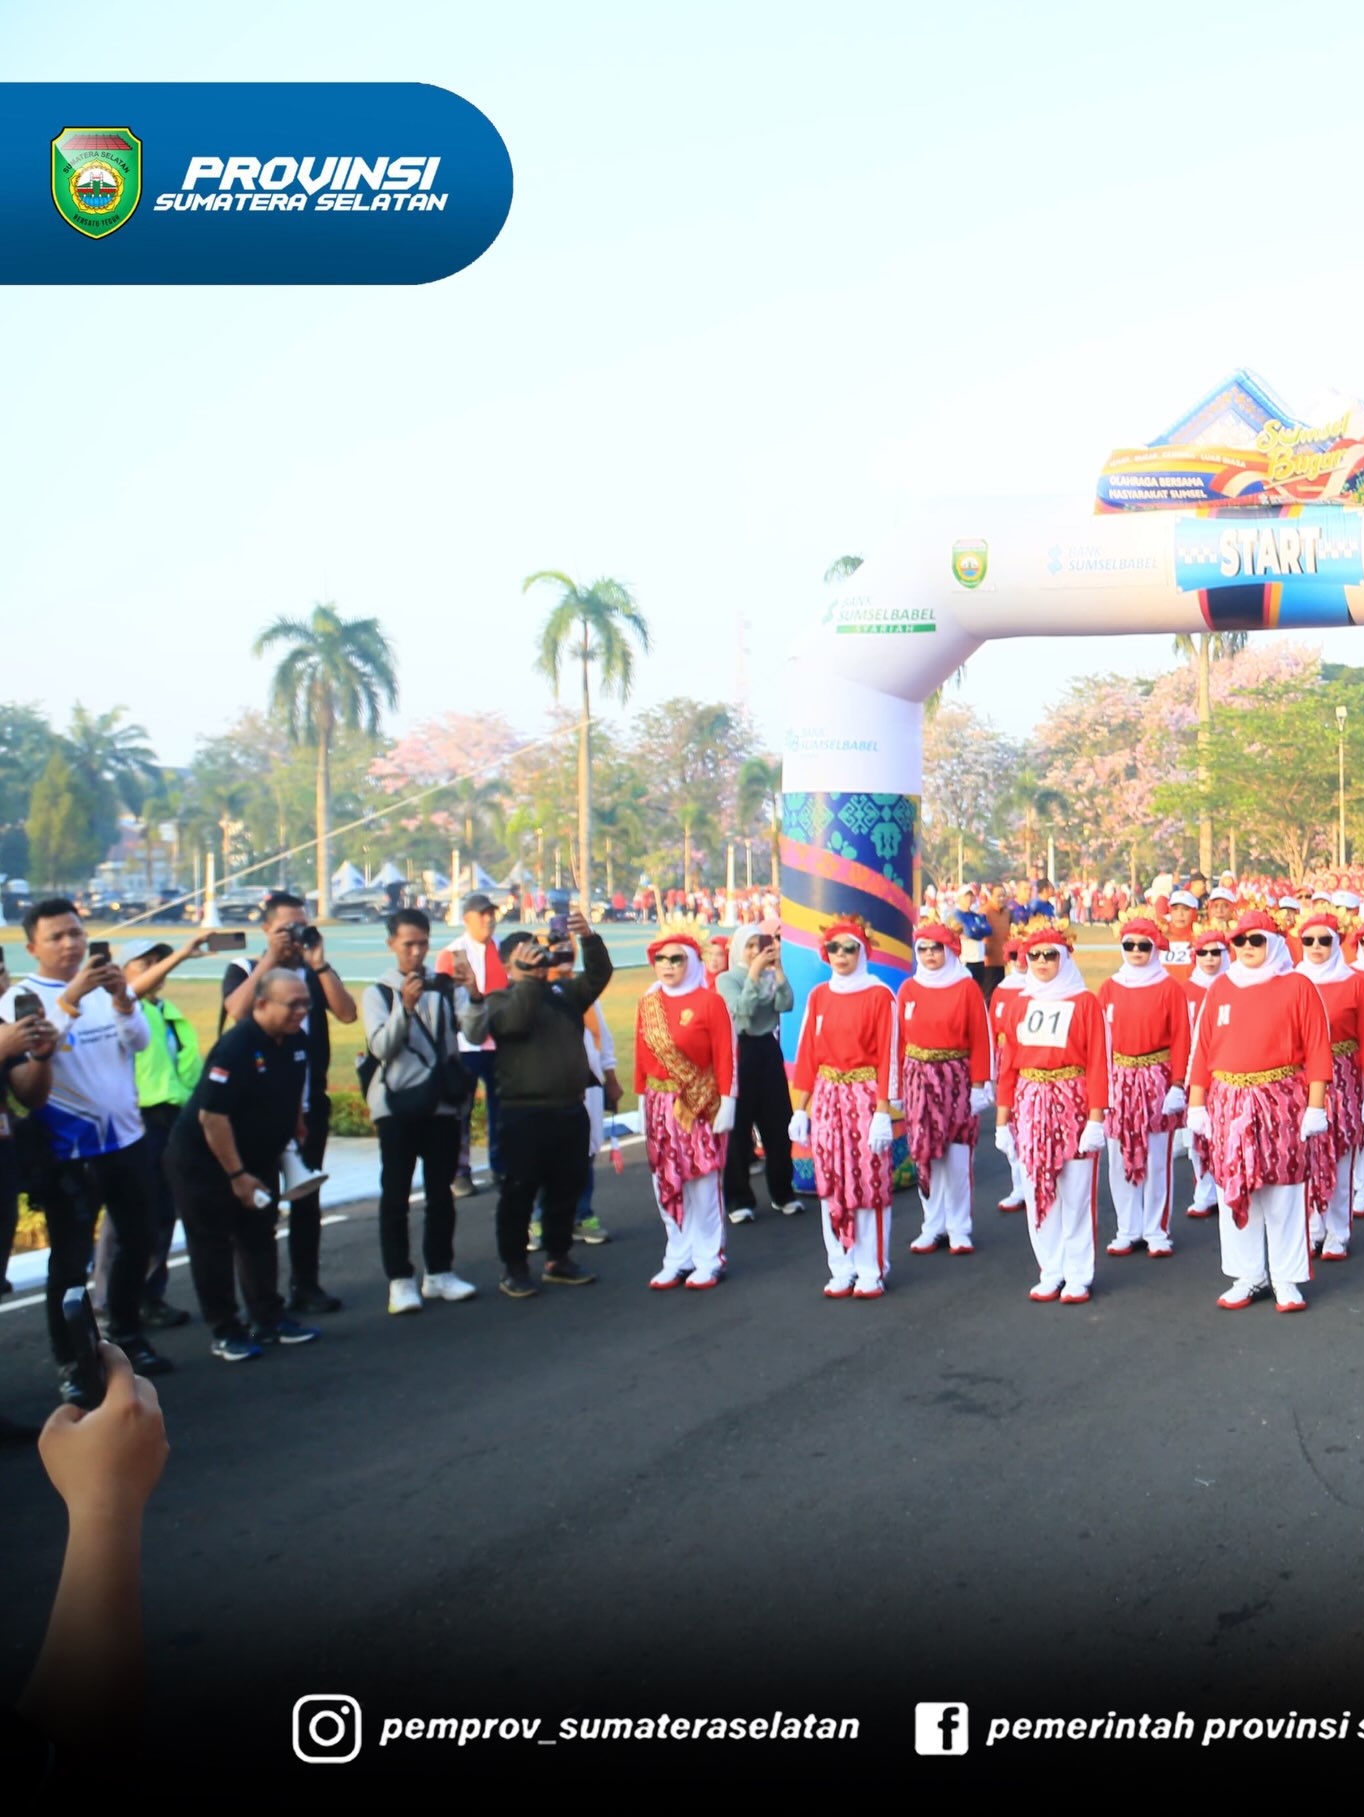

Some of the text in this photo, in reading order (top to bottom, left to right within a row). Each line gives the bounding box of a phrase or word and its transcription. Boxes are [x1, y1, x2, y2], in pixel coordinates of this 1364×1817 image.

[1255, 410, 1354, 453] Sumsel
[1267, 446, 1350, 481] Bugar
[1219, 526, 1323, 577] START
[838, 607, 936, 622] SUMSELBABEL
[1165, 950, 1187, 963] 02
[1028, 1009, 1061, 1035] 01
